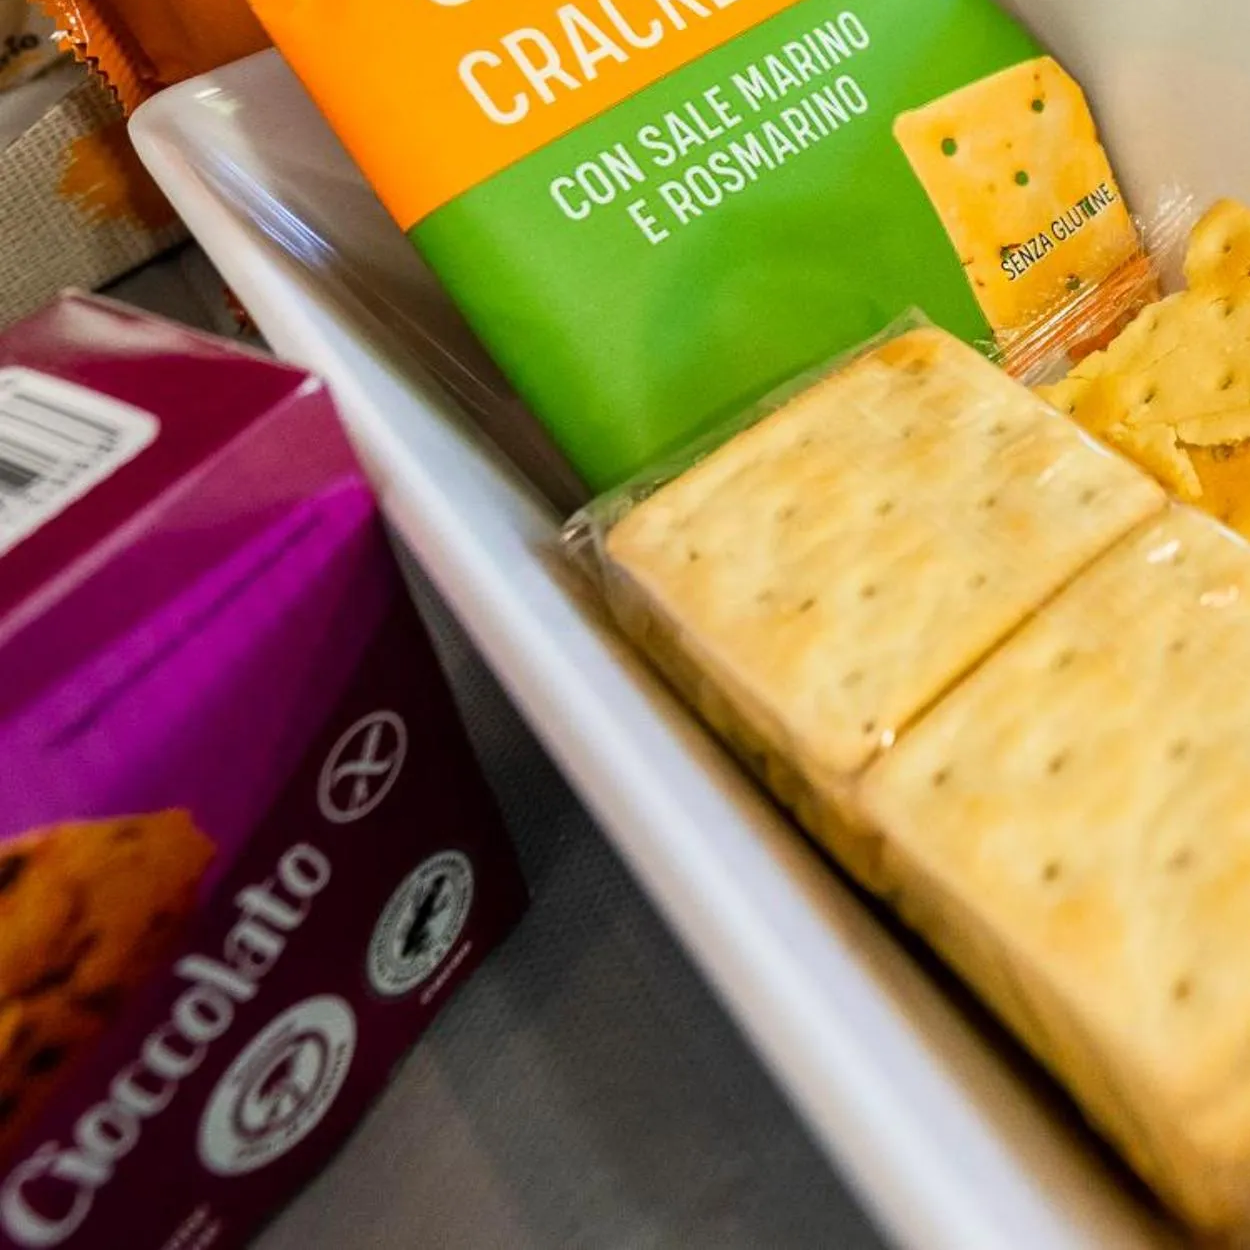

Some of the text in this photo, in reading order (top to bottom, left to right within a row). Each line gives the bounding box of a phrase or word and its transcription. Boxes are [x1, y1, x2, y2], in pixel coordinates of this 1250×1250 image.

[549, 10, 871, 221] CON SALE MARINO
[626, 73, 869, 246] E ROSMARINO
[1000, 183, 1115, 281] SENZA GLUTINE
[1, 842, 332, 1249] Cioccolato
